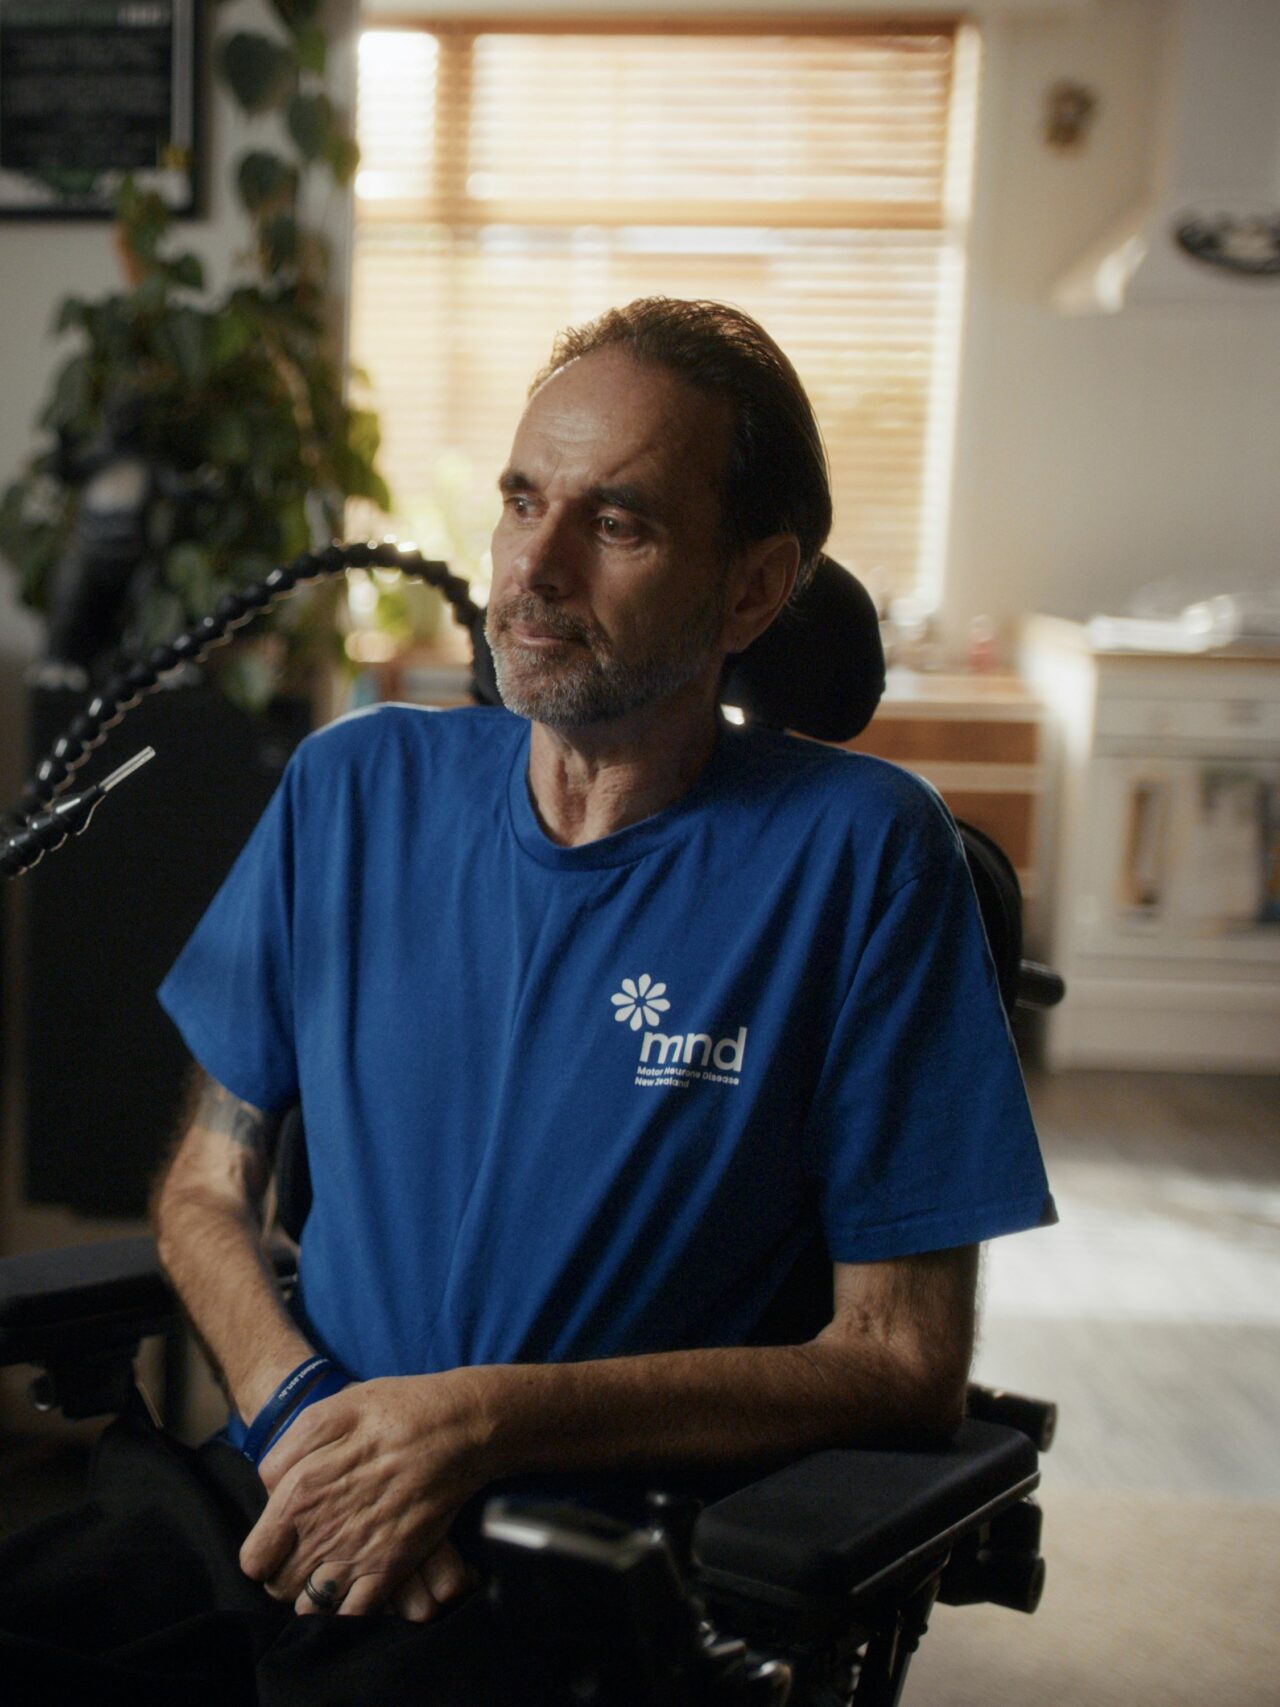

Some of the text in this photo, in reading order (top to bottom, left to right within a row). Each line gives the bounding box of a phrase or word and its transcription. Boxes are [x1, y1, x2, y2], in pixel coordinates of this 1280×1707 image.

[639, 1026, 748, 1072] mnd
[634, 1076, 689, 1088] New Zealand
[637, 1066, 740, 1085] Motor Neurone Disease
